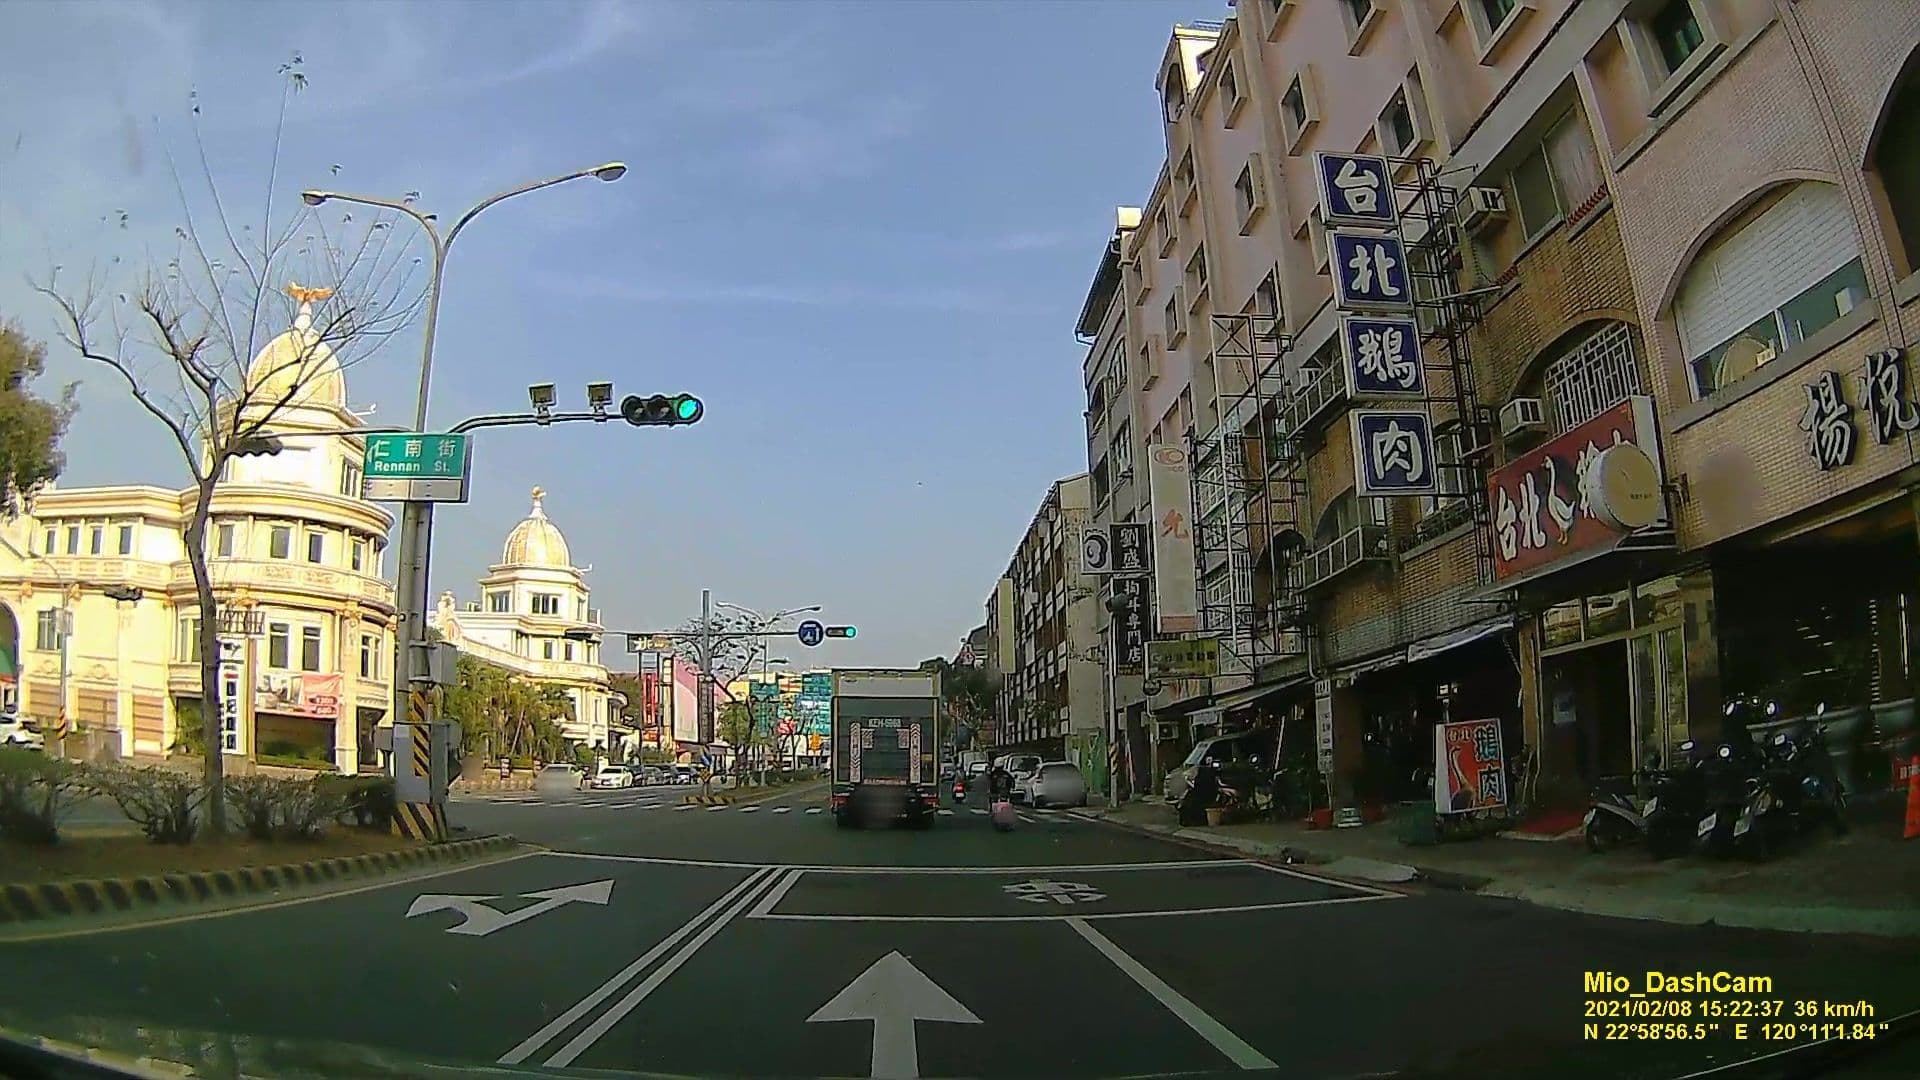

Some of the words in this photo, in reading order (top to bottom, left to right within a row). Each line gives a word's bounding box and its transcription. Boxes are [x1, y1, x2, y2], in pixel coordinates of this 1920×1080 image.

[374, 439, 458, 458] 仁南街
[374, 460, 421, 472] Rennan
[434, 460, 450, 472] St.
[1474, 725, 1503, 802] 鵝肉
